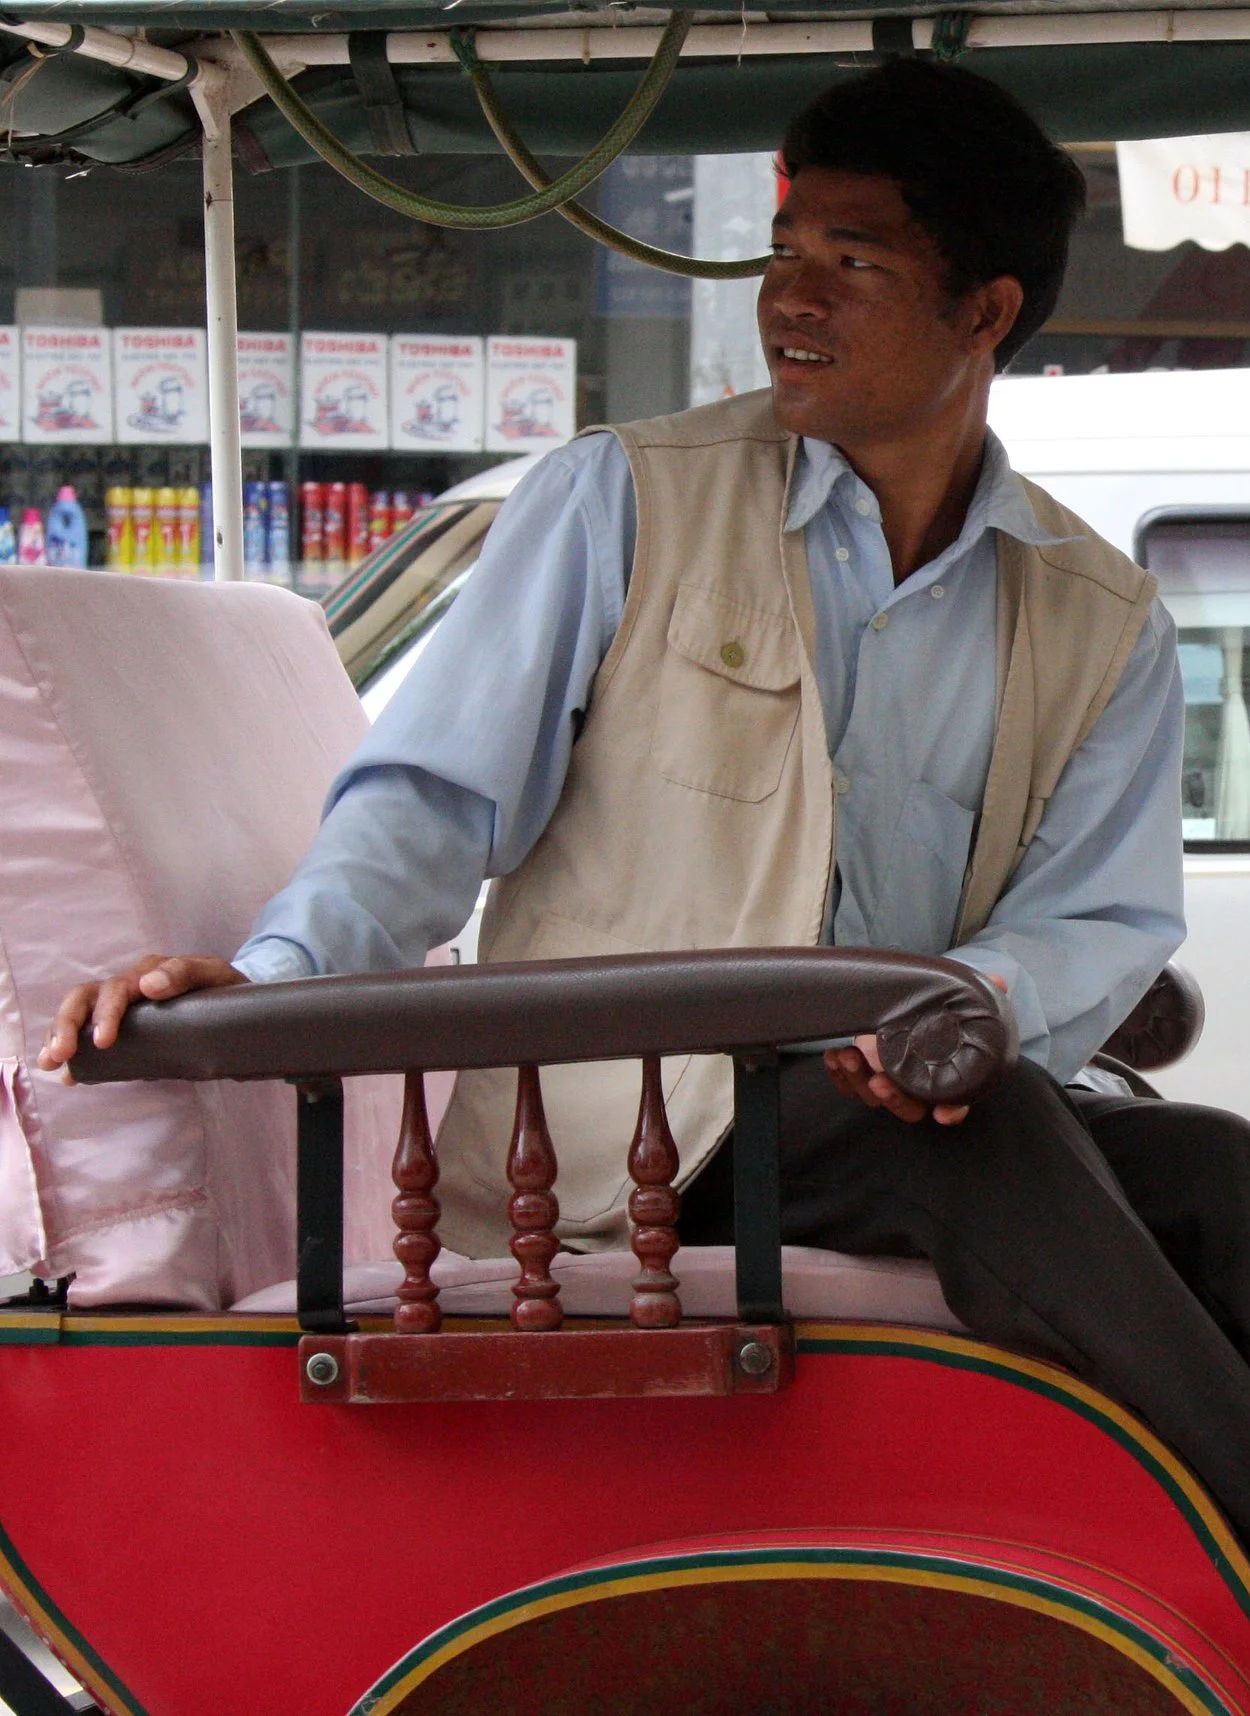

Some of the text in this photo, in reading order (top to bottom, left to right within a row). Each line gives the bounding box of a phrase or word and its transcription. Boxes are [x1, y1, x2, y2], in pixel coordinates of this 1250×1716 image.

[1172, 163, 1250, 206] 011
[25, 333, 101, 348] TOSHIBA
[122, 334, 197, 347] TOSHIBA
[238, 338, 287, 352] SHIBA
[304, 340, 380, 354] TOSHIBA
[400, 343, 473, 357] TOSHIBA
[492, 343, 565, 357] TOSHIBA
